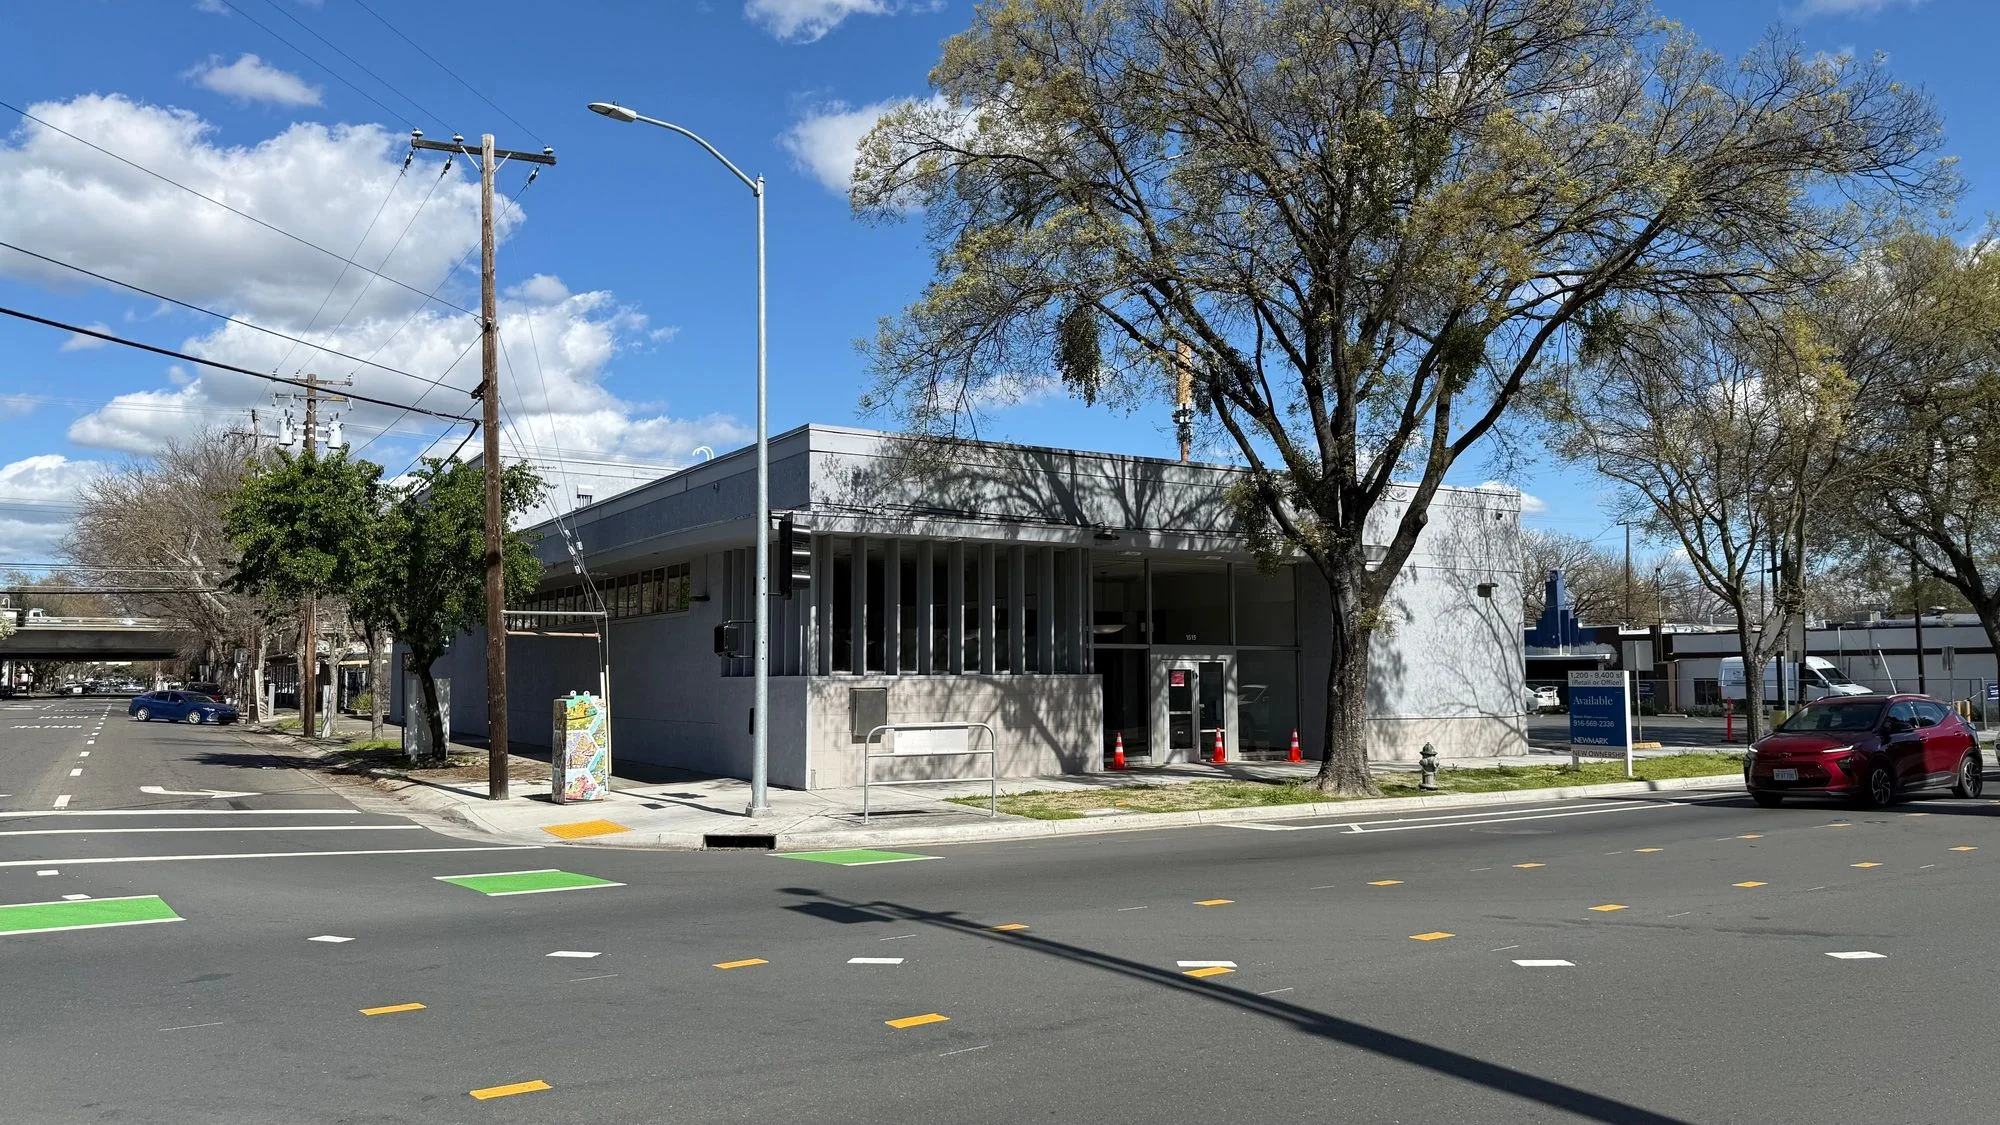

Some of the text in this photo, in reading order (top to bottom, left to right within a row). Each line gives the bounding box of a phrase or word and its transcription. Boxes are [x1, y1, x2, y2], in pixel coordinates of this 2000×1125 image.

[1573, 696, 1613, 706] Available
[1574, 737, 1608, 745] NEWMARK
[1572, 749, 1587, 757] NEW
